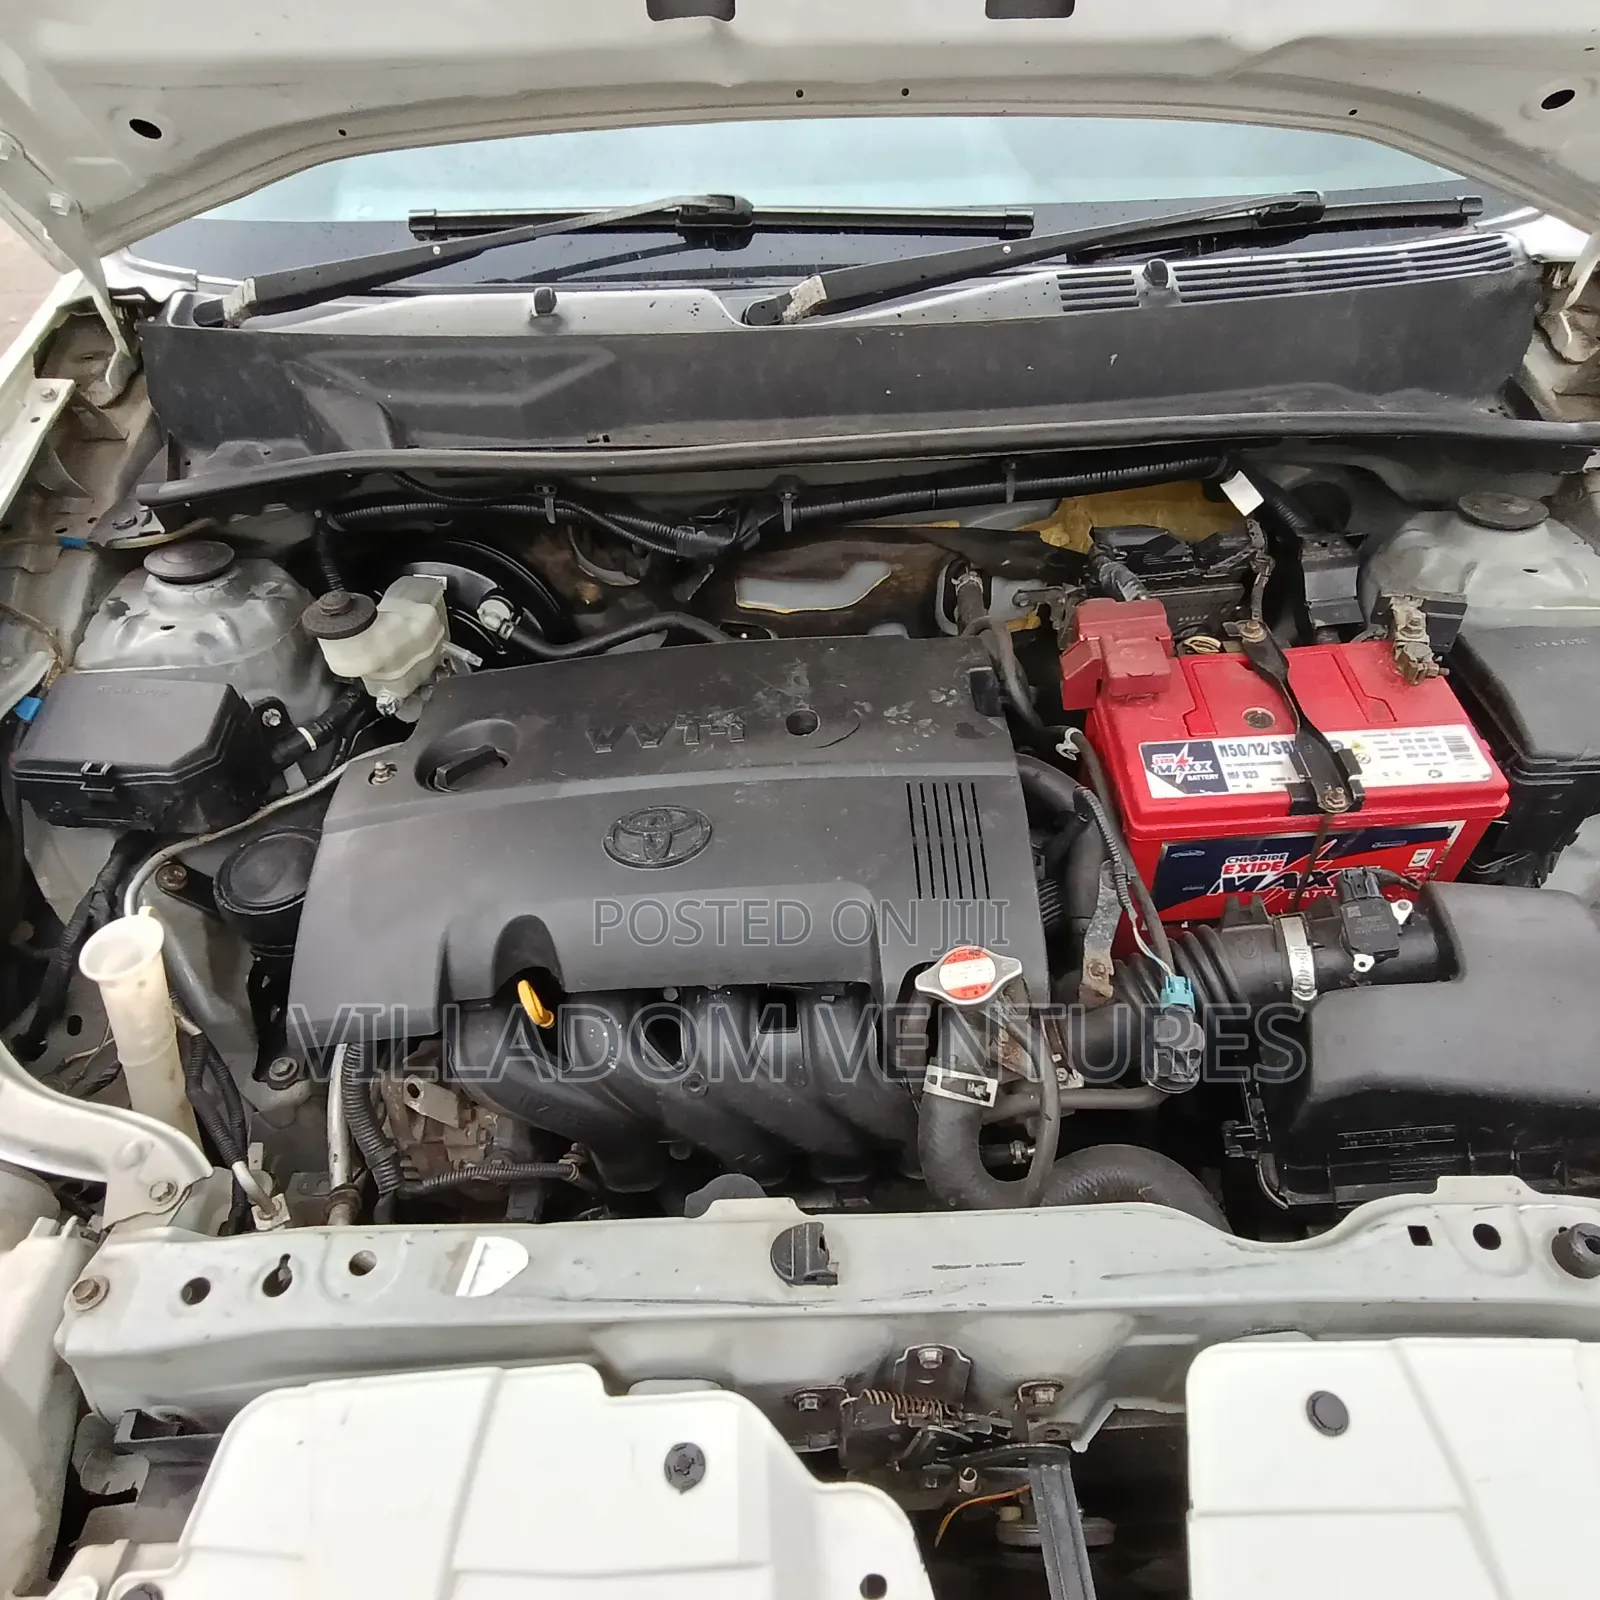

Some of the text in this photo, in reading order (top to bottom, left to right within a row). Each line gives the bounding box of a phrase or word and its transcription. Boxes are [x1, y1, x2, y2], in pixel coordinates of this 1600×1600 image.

[1151, 760, 1214, 775] MAXX
[1226, 852, 1289, 864] CHLORIDE
[1222, 860, 1285, 875] EXIDE
